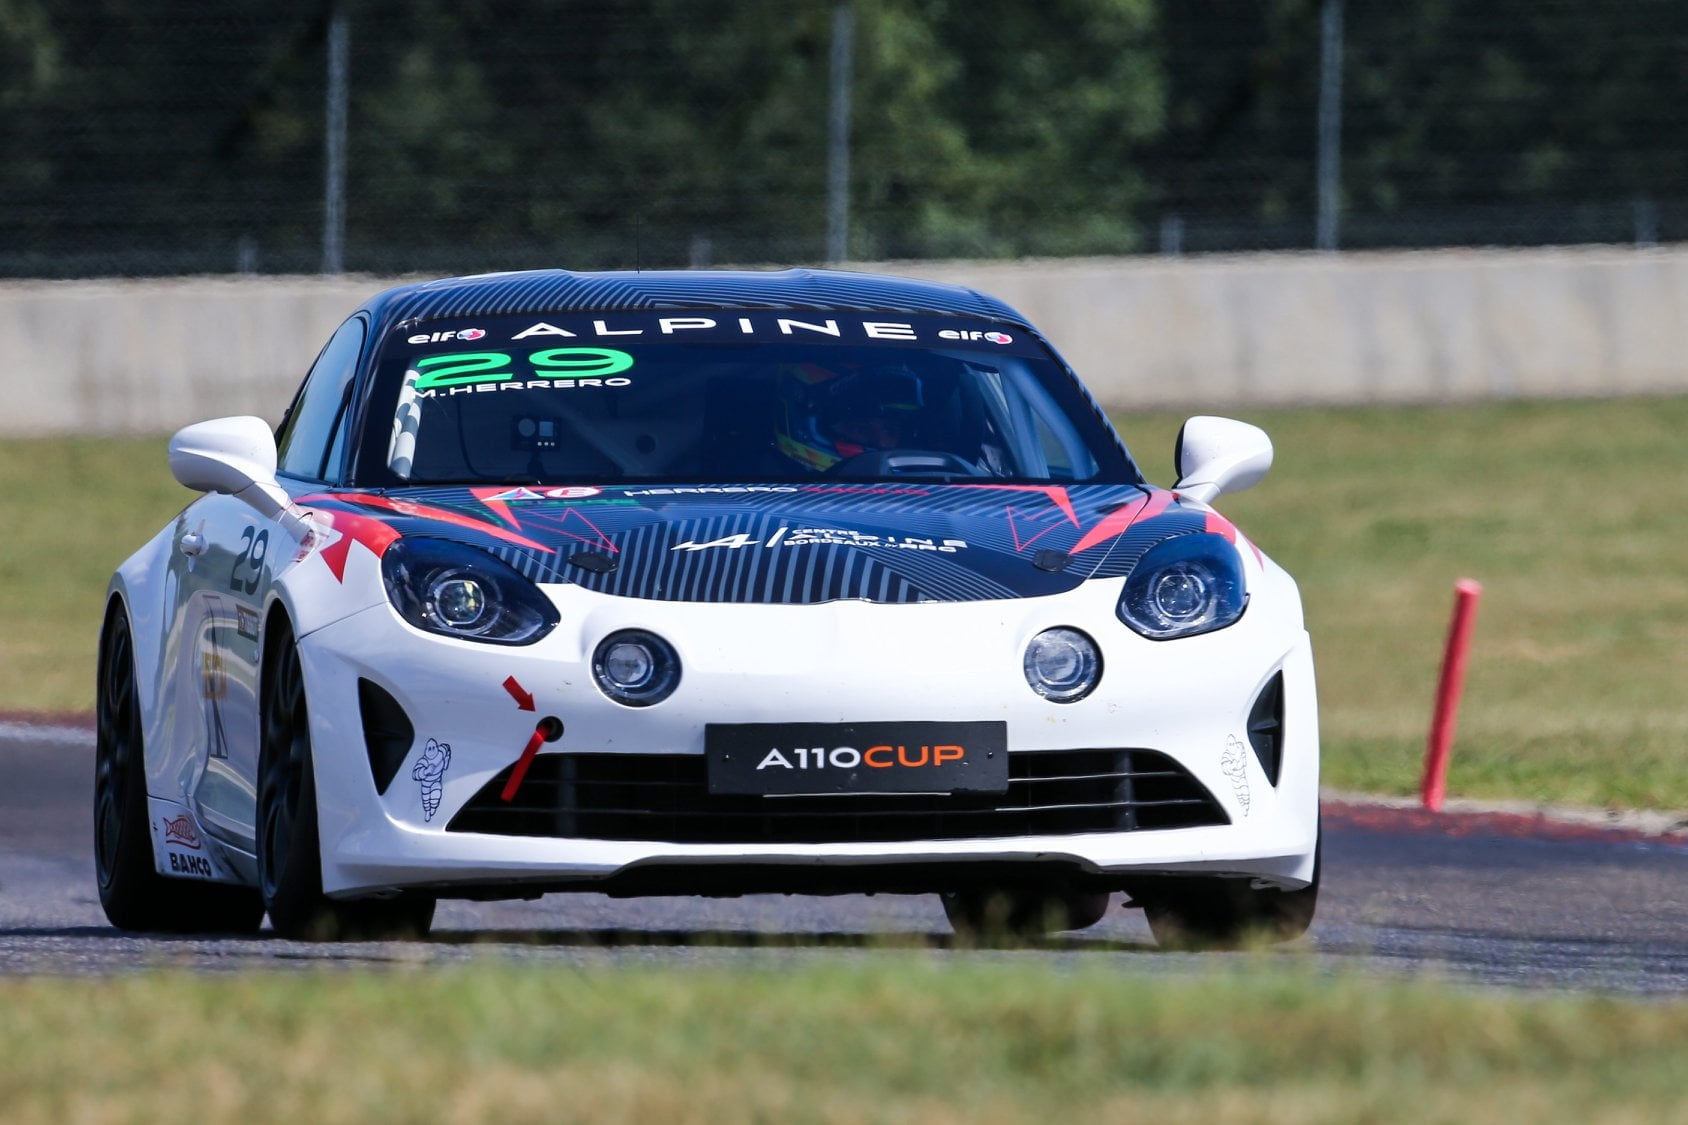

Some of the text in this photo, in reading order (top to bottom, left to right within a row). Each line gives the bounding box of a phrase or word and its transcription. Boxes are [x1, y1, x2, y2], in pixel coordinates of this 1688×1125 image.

[407, 330, 457, 344] elf
[511, 318, 917, 340] ALPINE
[938, 329, 984, 341] elf
[414, 347, 634, 389] 29
[412, 378, 631, 398] M.HERRERO
[624, 487, 798, 496] HERRERO
[784, 539, 881, 547] BORDEAUX
[788, 533, 967, 549] ALPINE
[230, 525, 269, 595] 29
[169, 852, 212, 877] BAHCO
